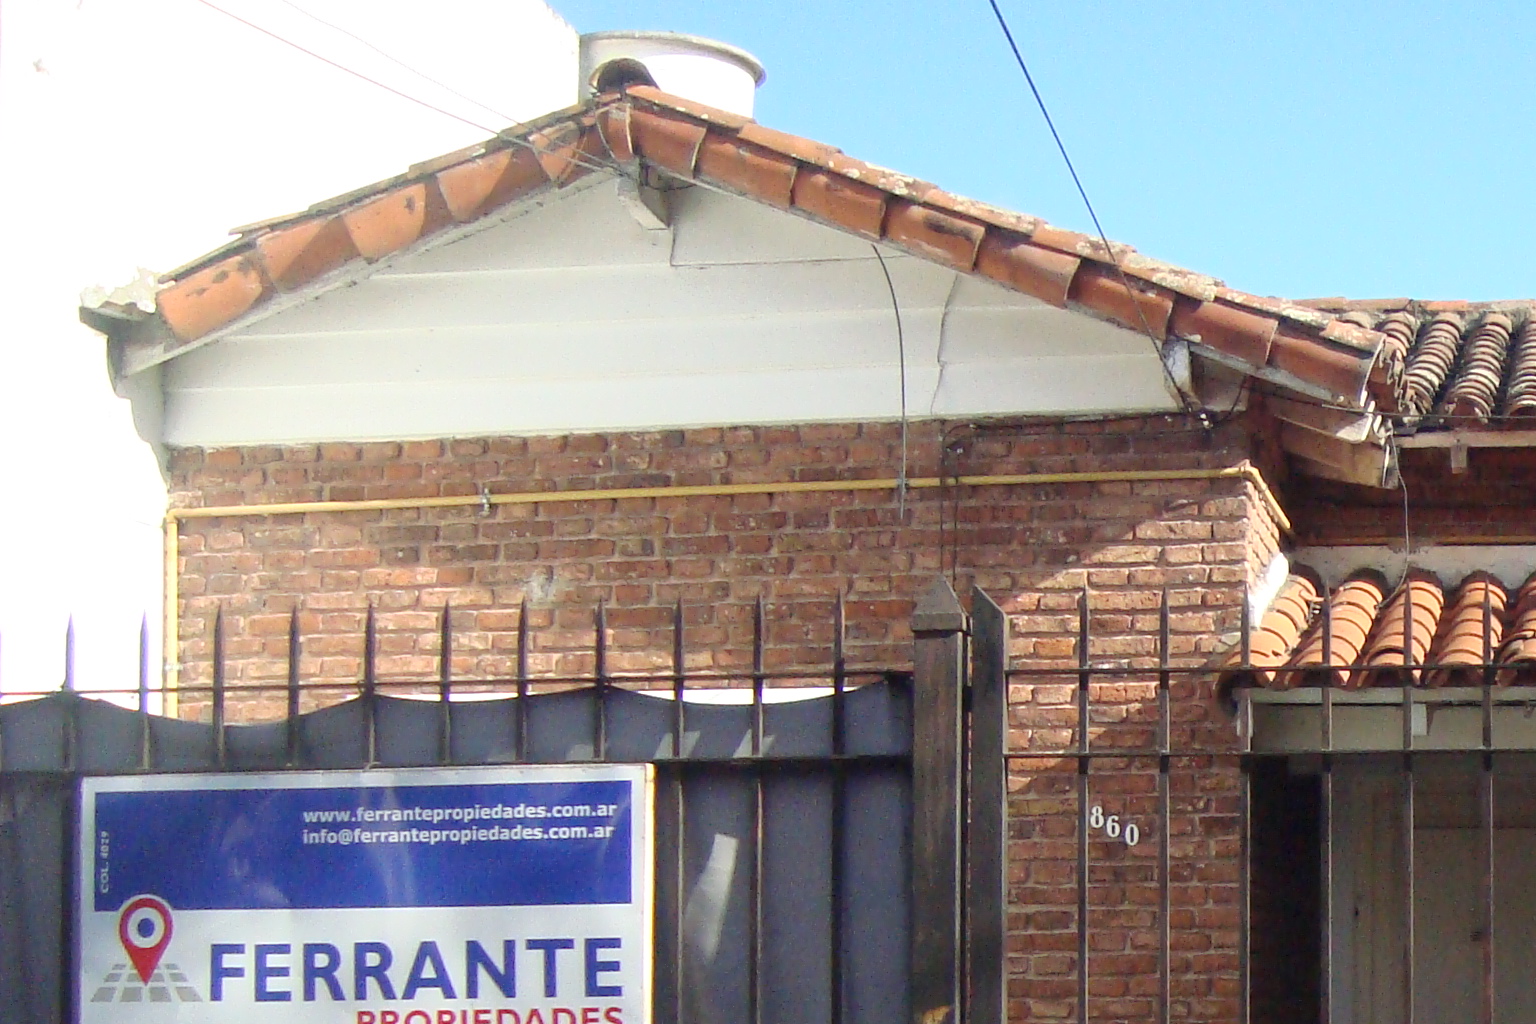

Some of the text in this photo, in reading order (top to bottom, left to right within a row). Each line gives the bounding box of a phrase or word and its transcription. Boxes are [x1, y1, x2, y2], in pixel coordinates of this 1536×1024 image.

[303, 803, 618, 825] www.ferrantepropiedades.com.ar
[1090, 805, 1139, 846] 860
[303, 825, 615, 846] info@ferrantepropiedades.com.ar
[210, 938, 624, 1002] FERRANTE
